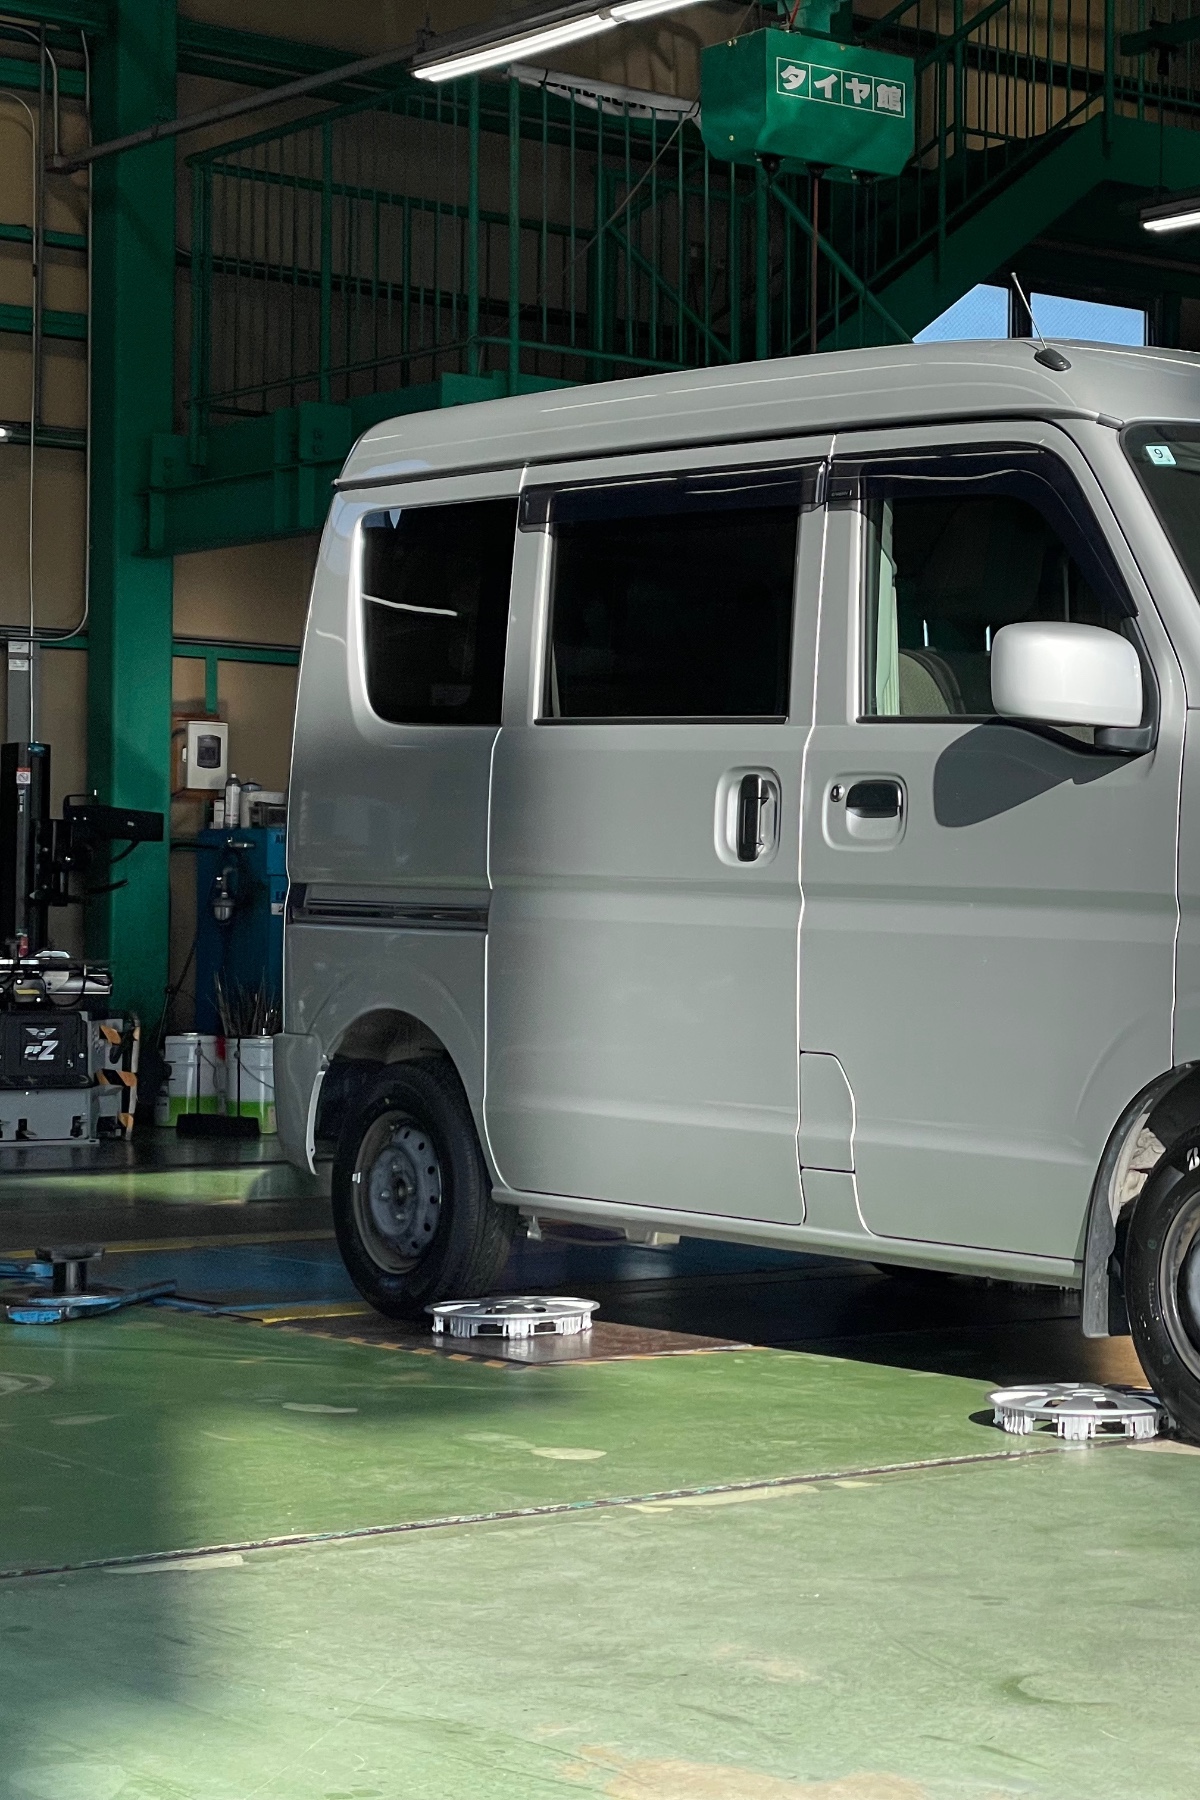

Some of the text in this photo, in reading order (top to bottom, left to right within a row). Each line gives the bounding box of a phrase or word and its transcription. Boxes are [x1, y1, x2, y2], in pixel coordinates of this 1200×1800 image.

[780, 65, 902, 112] タイヤ館
[1153, 448, 1163, 459] 9
